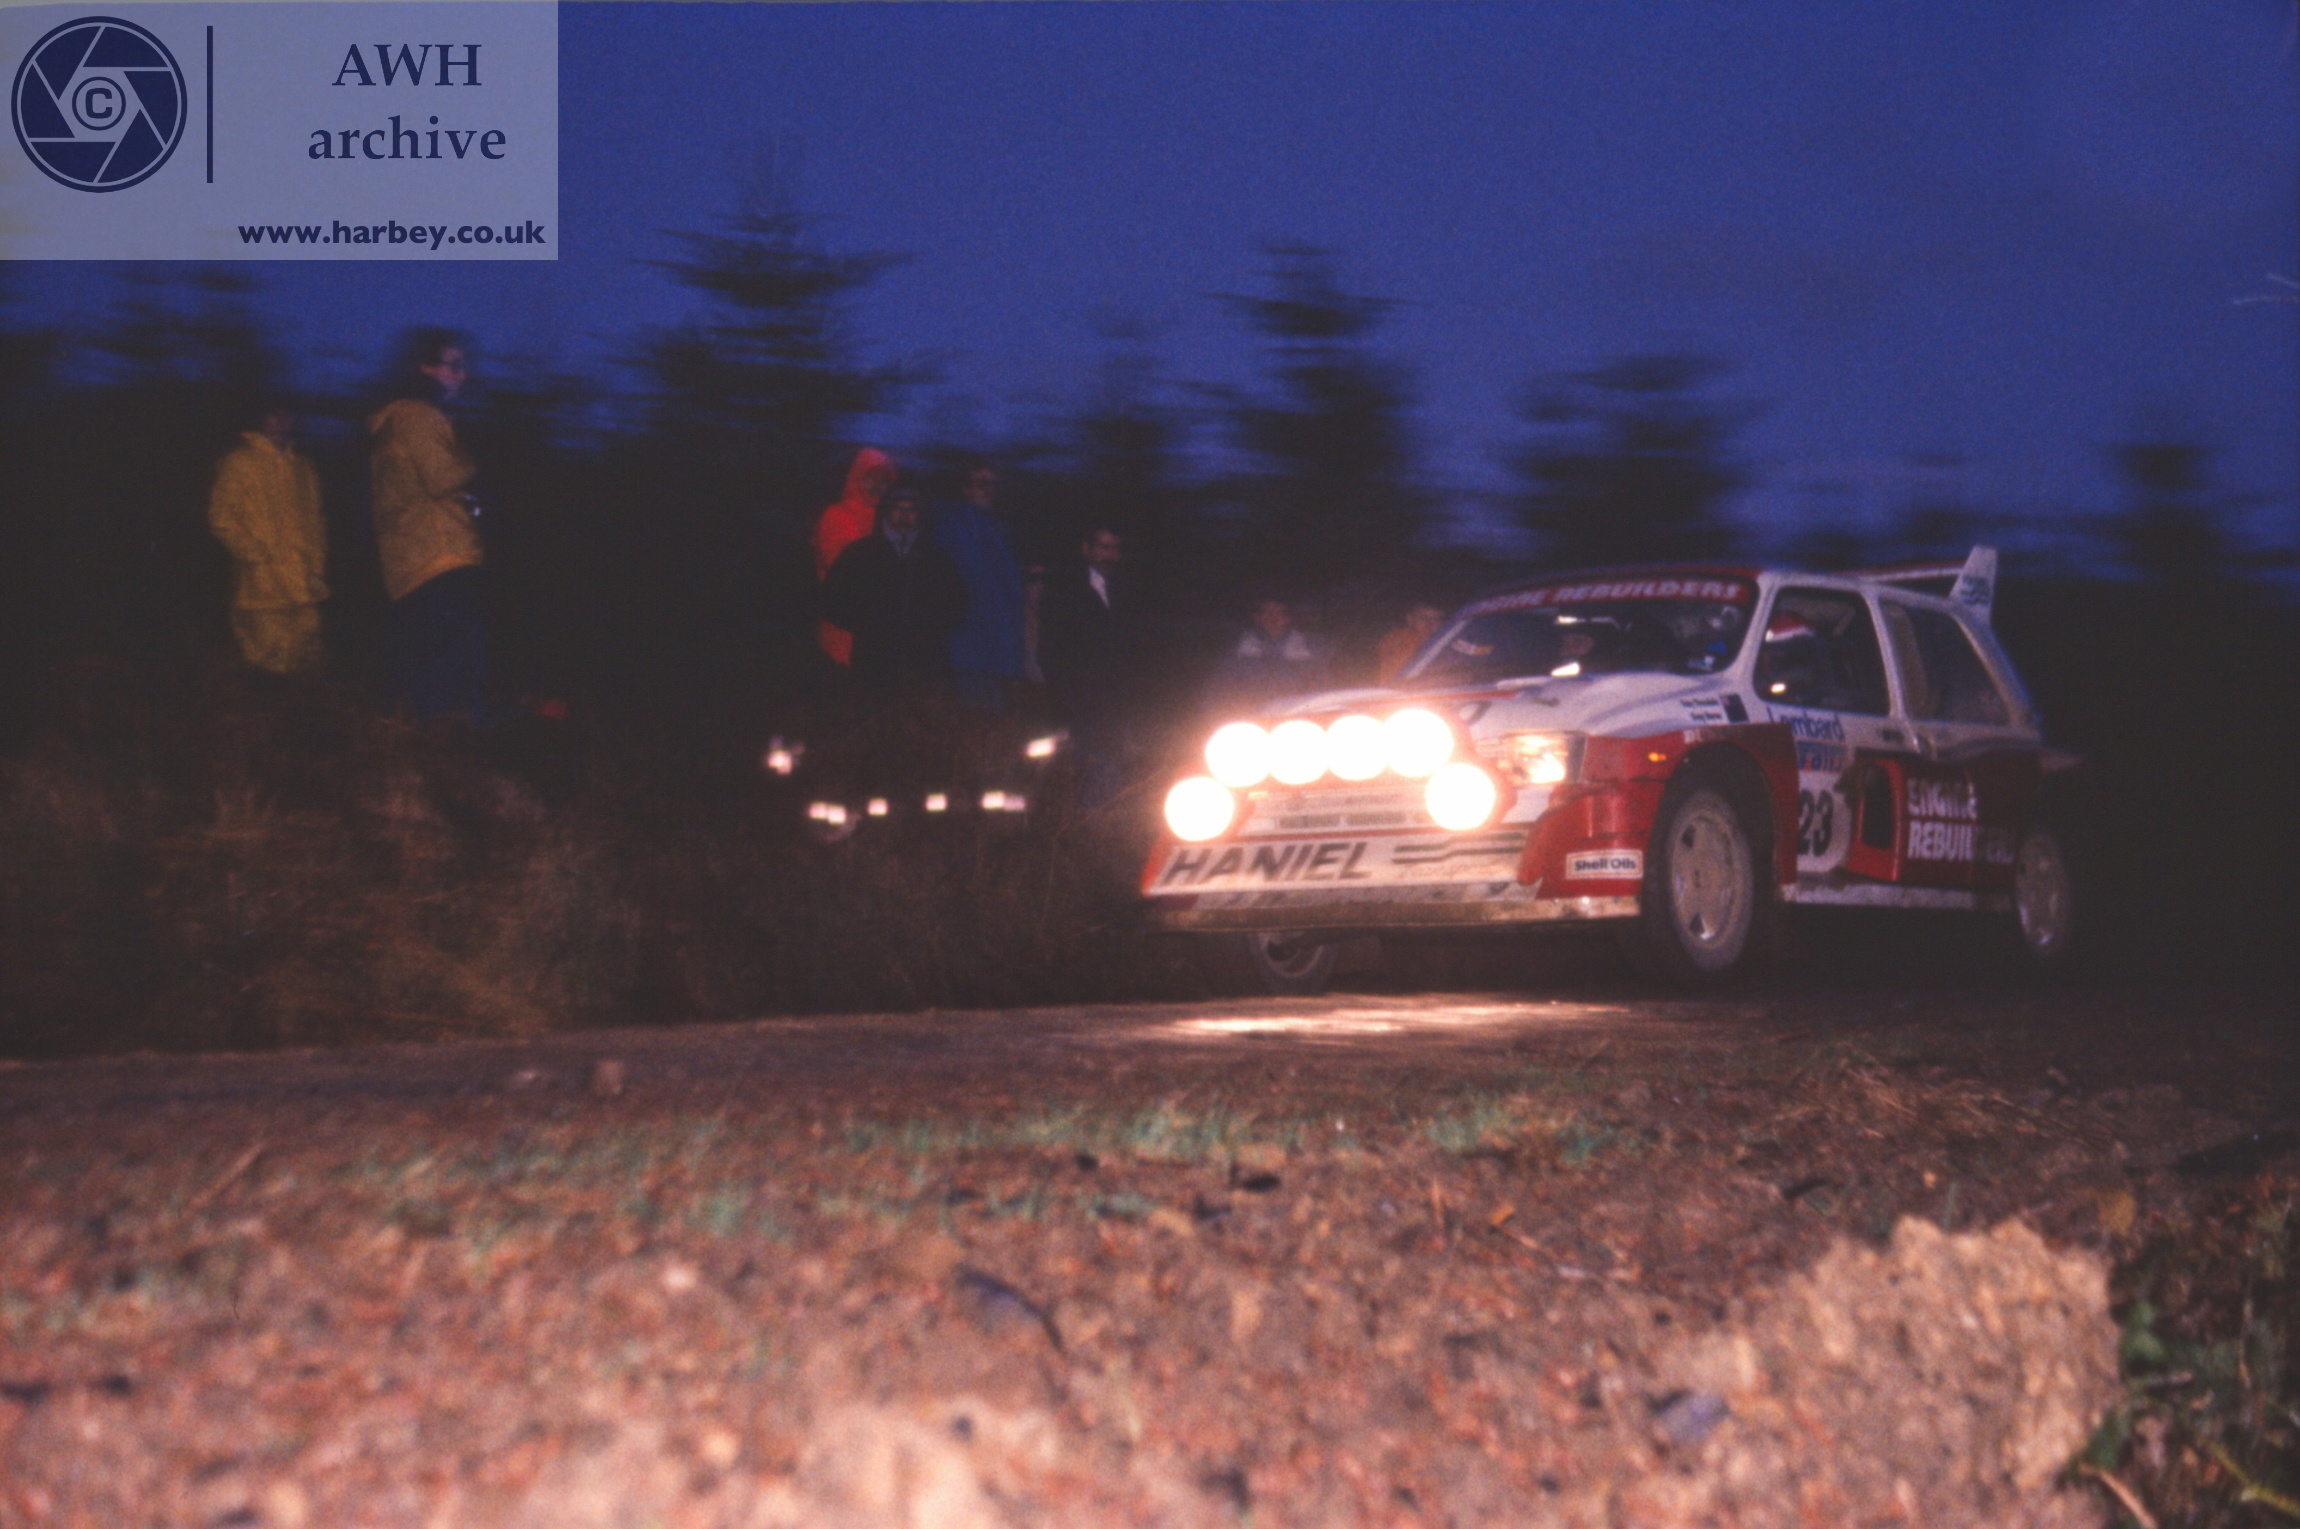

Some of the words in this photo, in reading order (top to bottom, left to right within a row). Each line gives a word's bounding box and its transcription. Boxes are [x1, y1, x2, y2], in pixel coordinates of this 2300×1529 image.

[1797, 789, 1834, 857] 23
[1160, 841, 1371, 887] HANIEL
[1574, 858, 1608, 871] Shell
